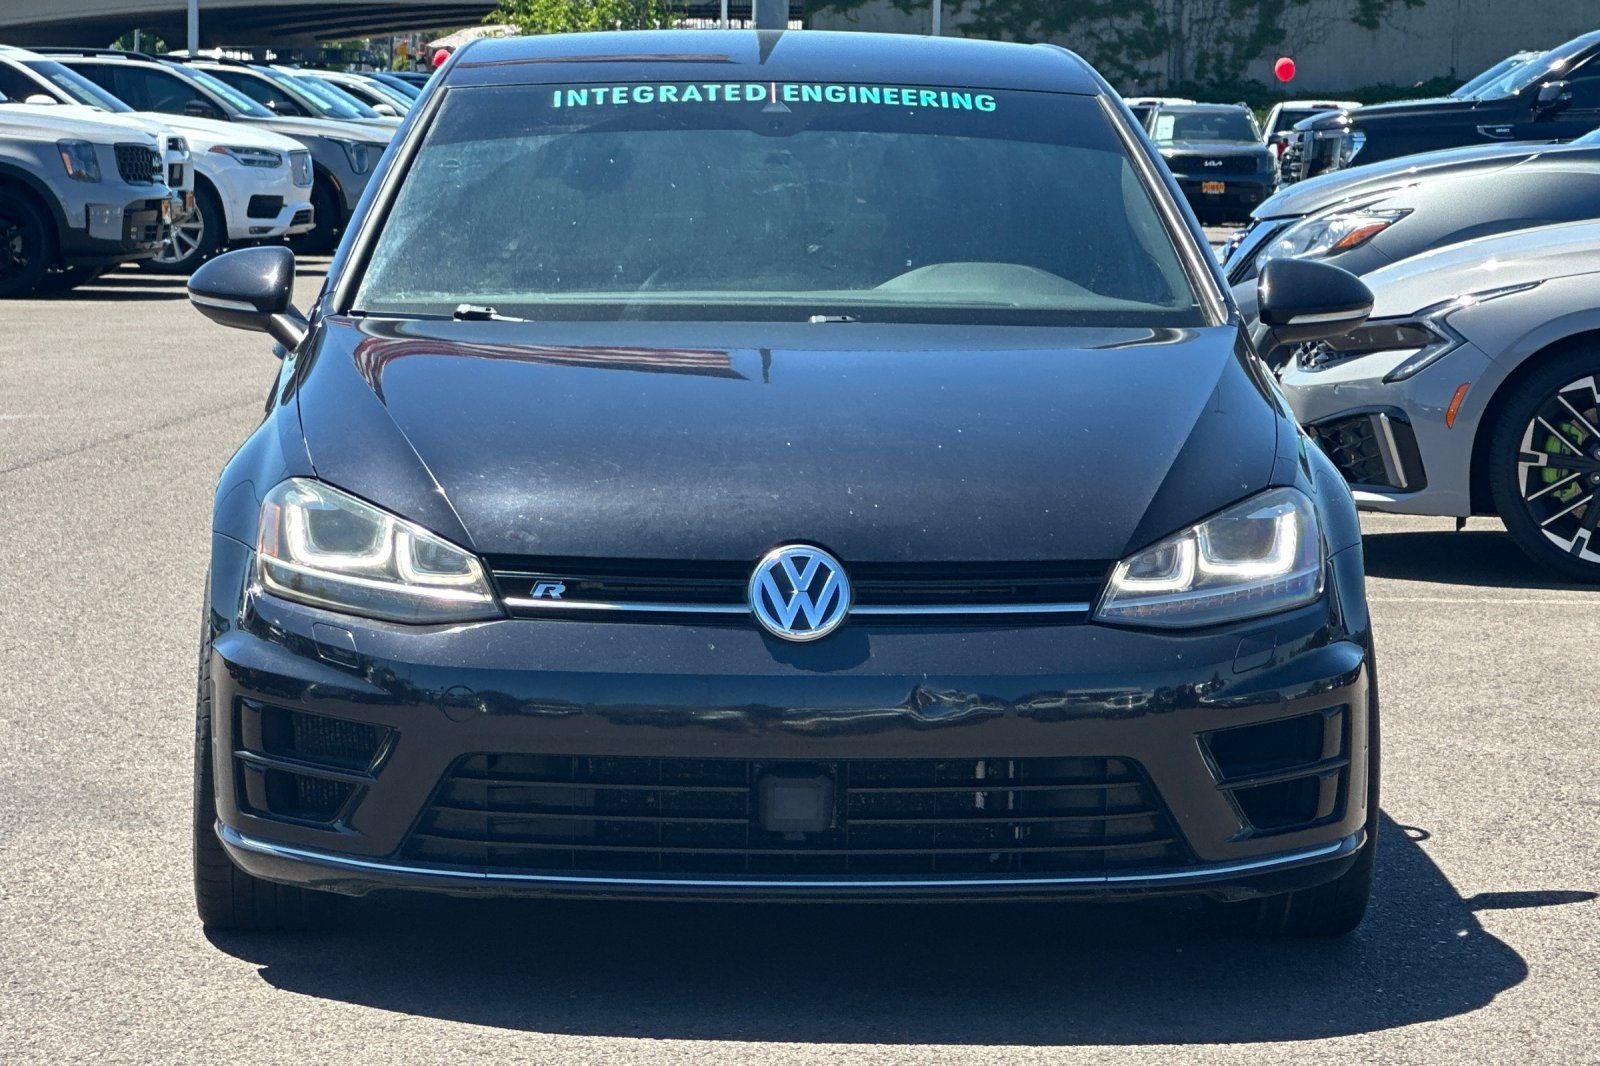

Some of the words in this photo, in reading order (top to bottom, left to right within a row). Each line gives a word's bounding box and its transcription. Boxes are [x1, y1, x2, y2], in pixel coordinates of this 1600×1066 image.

[552, 85, 767, 108] INTEGRATED
[783, 85, 996, 112] ENGINEERING
[530, 581, 566, 599] R
[757, 550, 843, 635] VW
